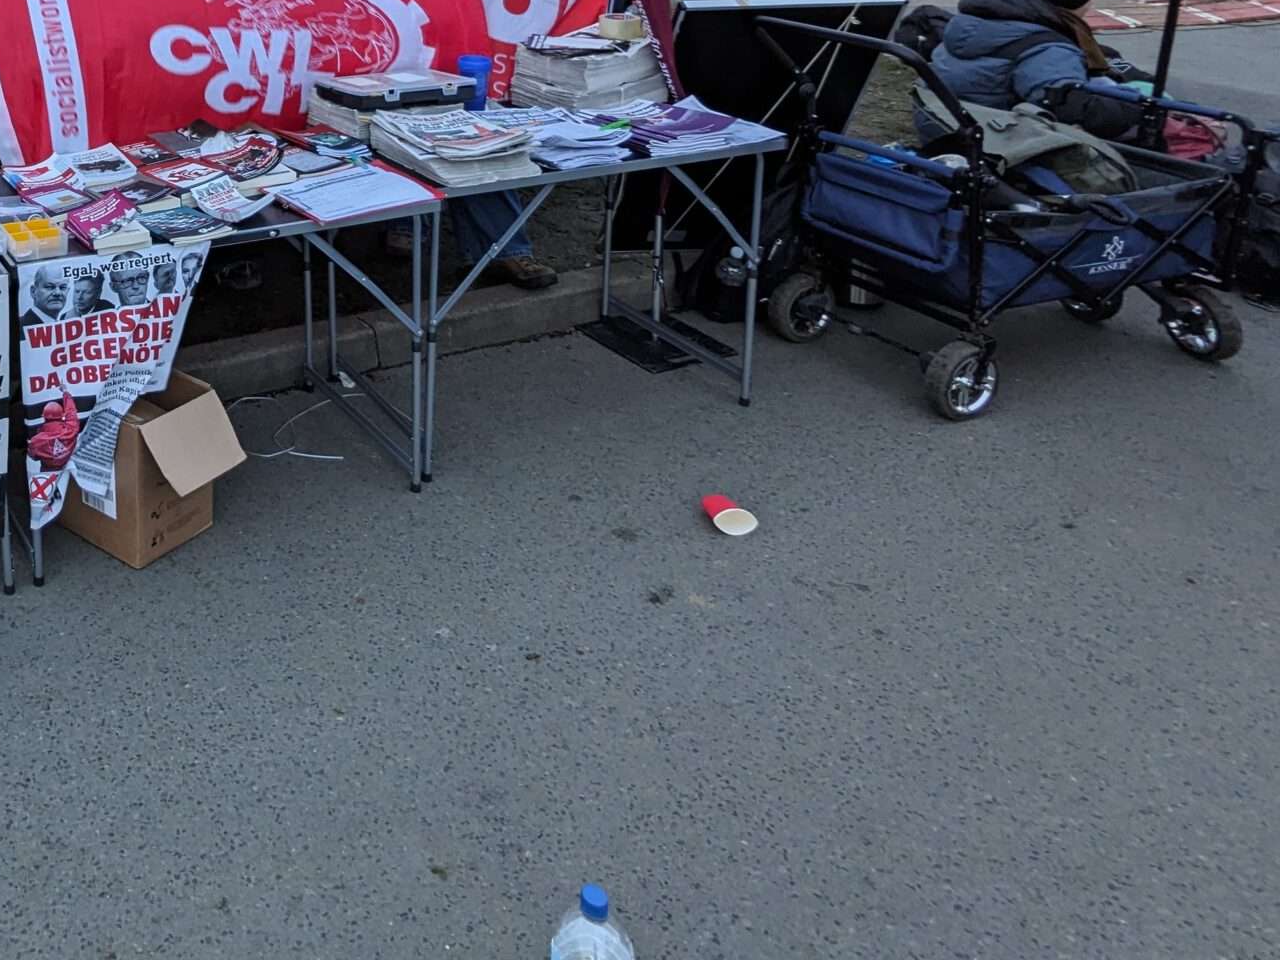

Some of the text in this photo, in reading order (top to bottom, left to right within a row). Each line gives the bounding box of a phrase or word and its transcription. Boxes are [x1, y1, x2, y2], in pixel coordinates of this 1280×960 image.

[62, 252, 177, 279] Egal, wer regiert,
[29, 371, 61, 393] DA
